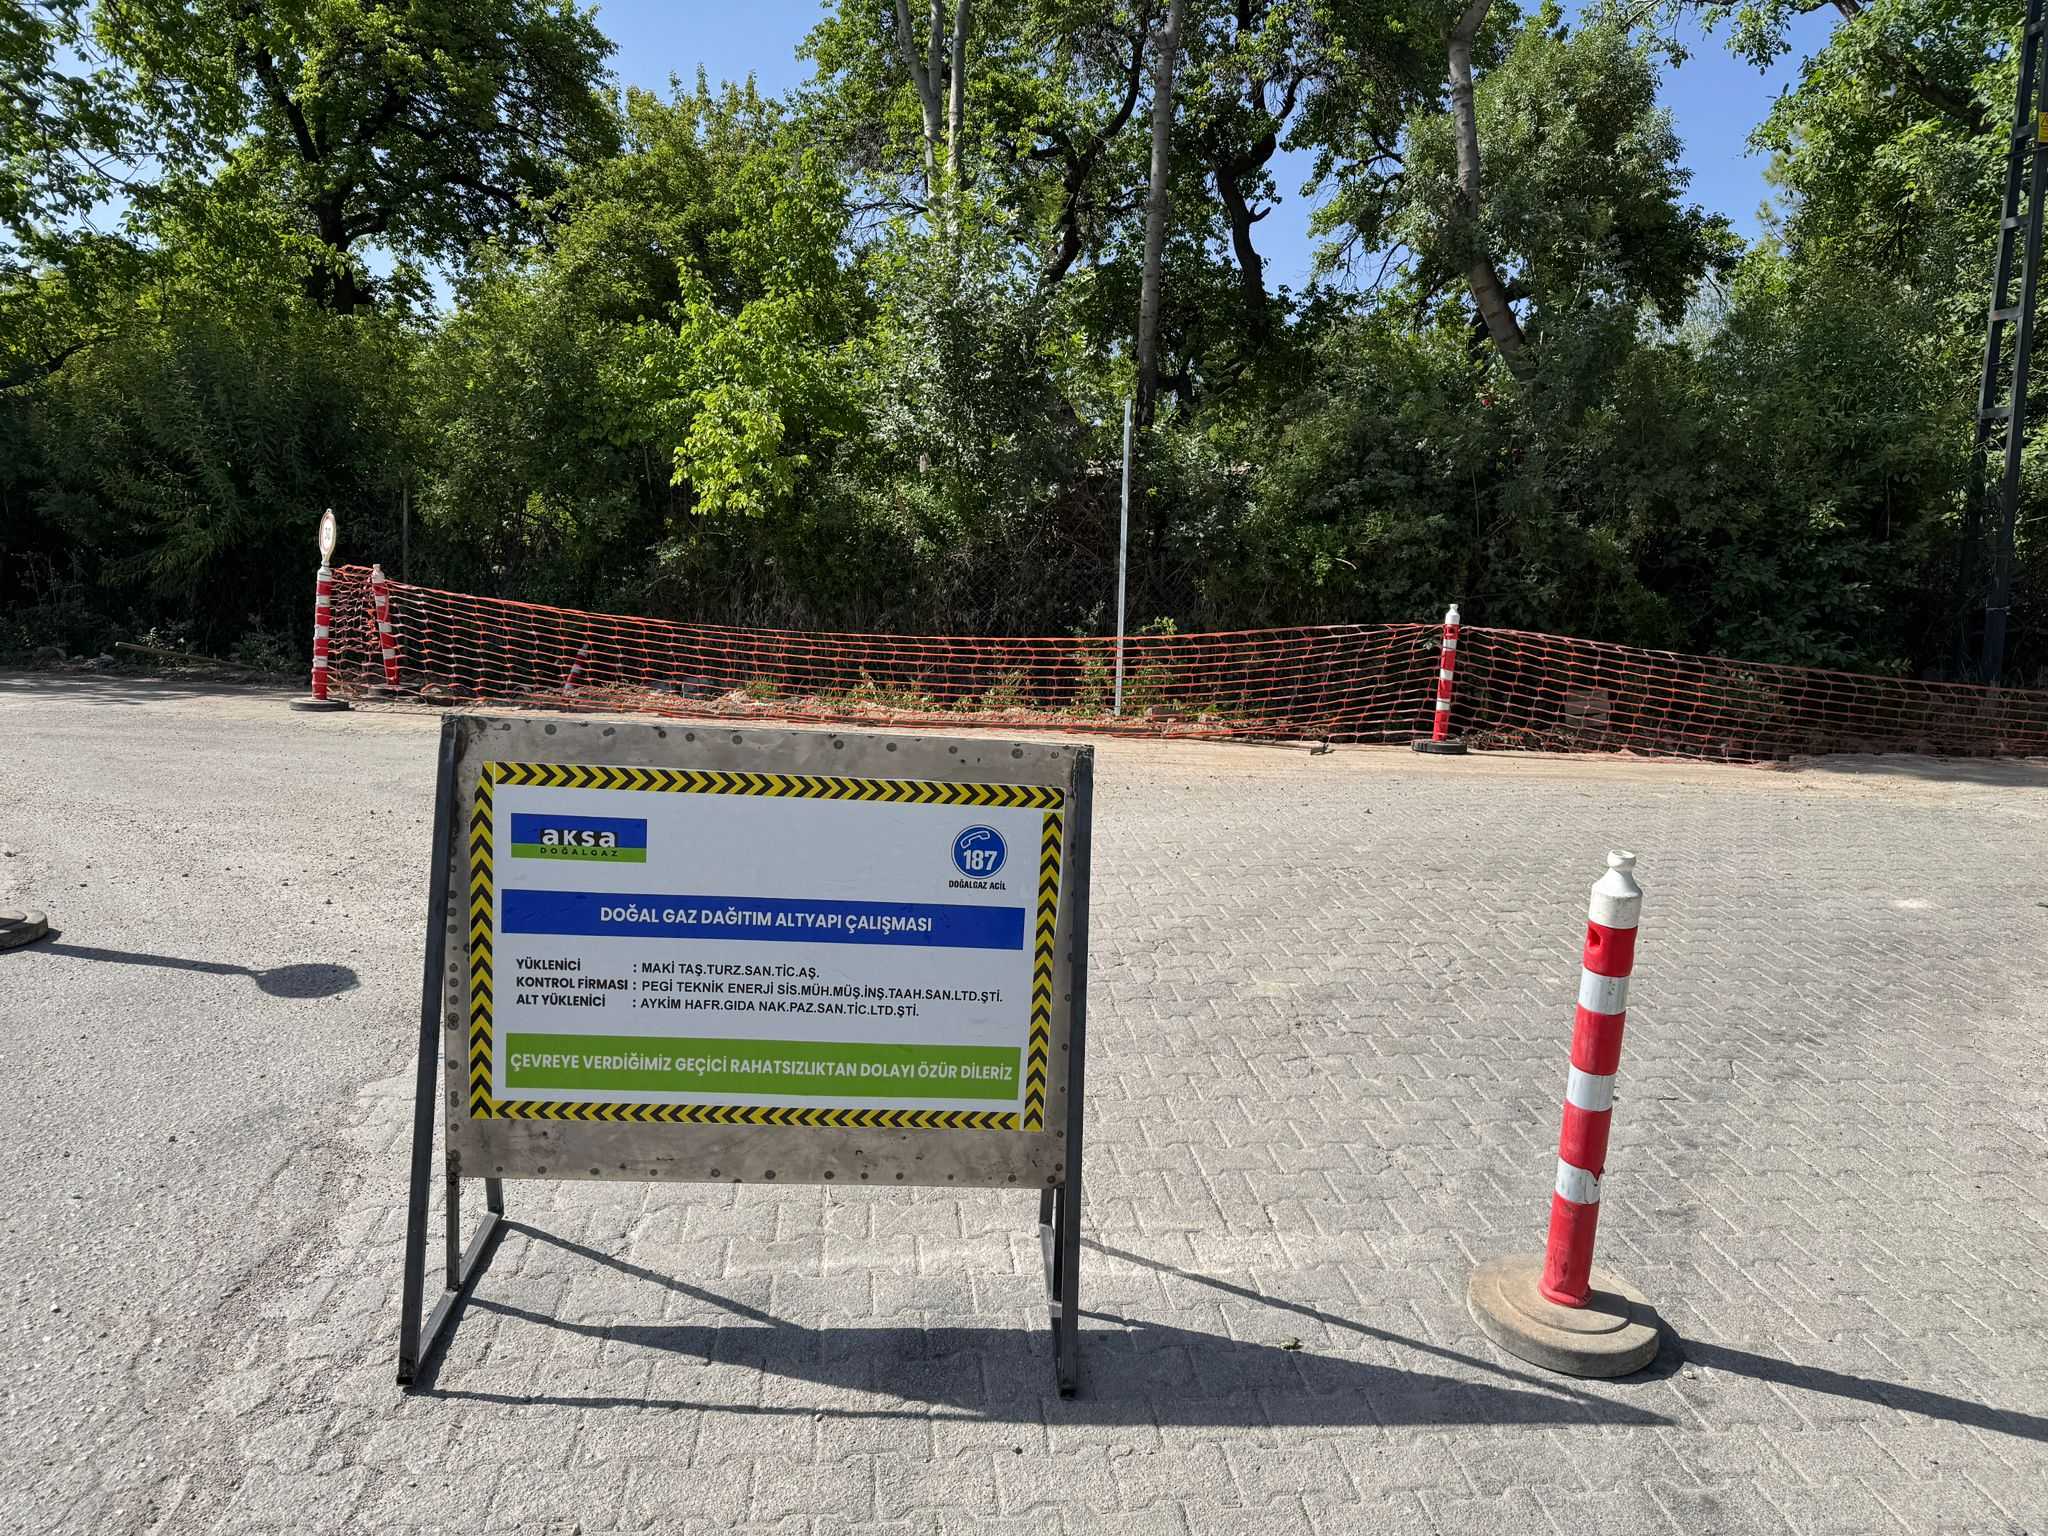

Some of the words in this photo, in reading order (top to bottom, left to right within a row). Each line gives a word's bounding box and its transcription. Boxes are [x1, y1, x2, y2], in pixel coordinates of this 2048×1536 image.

[542, 828, 616, 848] aksa
[540, 847, 619, 857] DOĞALGAZ
[963, 849, 998, 871] 187
[948, 879, 988, 890] DOĞALGAZ
[989, 880, 1006, 891] ACİL
[600, 904, 659, 923] DOĞAL
[662, 909, 697, 924] GAZ
[701, 906, 772, 926] DAĞITIM
[775, 913, 842, 929] ALTYAPI
[845, 915, 932, 935] ÇALIŞMASI
[516, 956, 581, 971] YÜKLENİCİ
[641, 961, 675, 974] MAKİ
[516, 976, 576, 989] KONTROL
[577, 976, 628, 991] FİRMASI
[641, 978, 673, 992] PEGİ
[676, 980, 724, 993] TEKNİK
[727, 982, 774, 995] ENERJİ
[516, 994, 539, 1006] ALT
[541, 992, 606, 1008] YÜKLENİCİ
[640, 996, 682, 1010] AYKİM
[685, 999, 756, 1012] HAFR.GIDA
[510, 1054, 579, 1072] ÇEVREYE
[582, 1052, 672, 1072] VERDİĞİMİZ
[675, 1055, 728, 1076] GEÇİCİ
[730, 1059, 857, 1077] RAHATSIZLIKTAN
[860, 1063, 915, 1078] DOLAYI
[918, 1060, 957, 1079] ÖZÜR
[960, 1061, 1012, 1081] DİLERİZ
